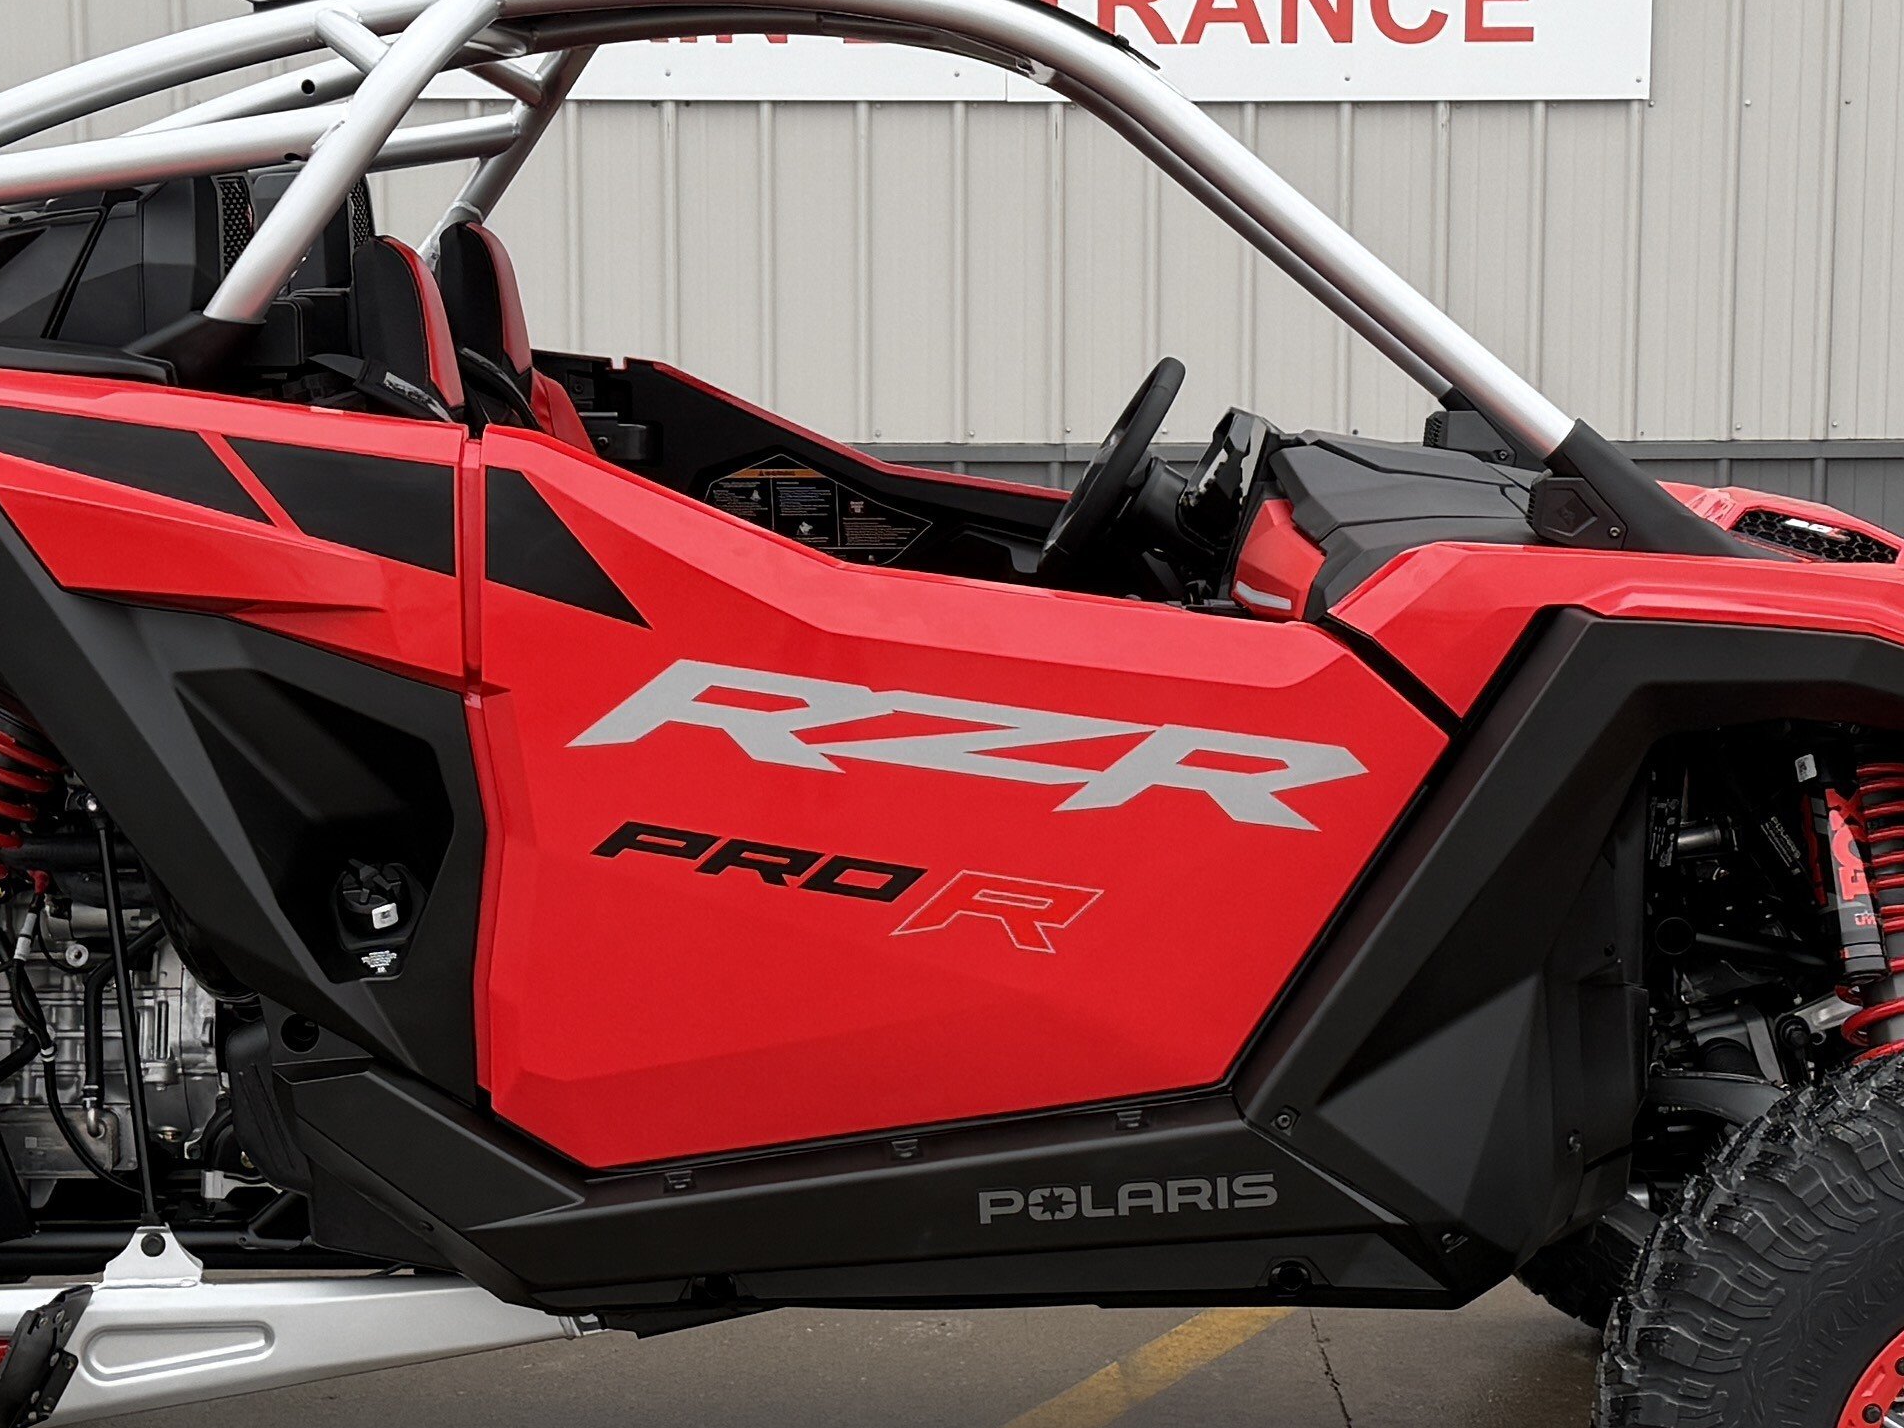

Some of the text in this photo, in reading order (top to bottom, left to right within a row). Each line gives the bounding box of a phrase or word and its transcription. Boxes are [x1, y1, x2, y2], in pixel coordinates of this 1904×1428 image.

[565, 659, 1369, 831] RZR
[591, 821, 1105, 954] PRO R
[979, 1173, 1278, 1224] POLARIS
